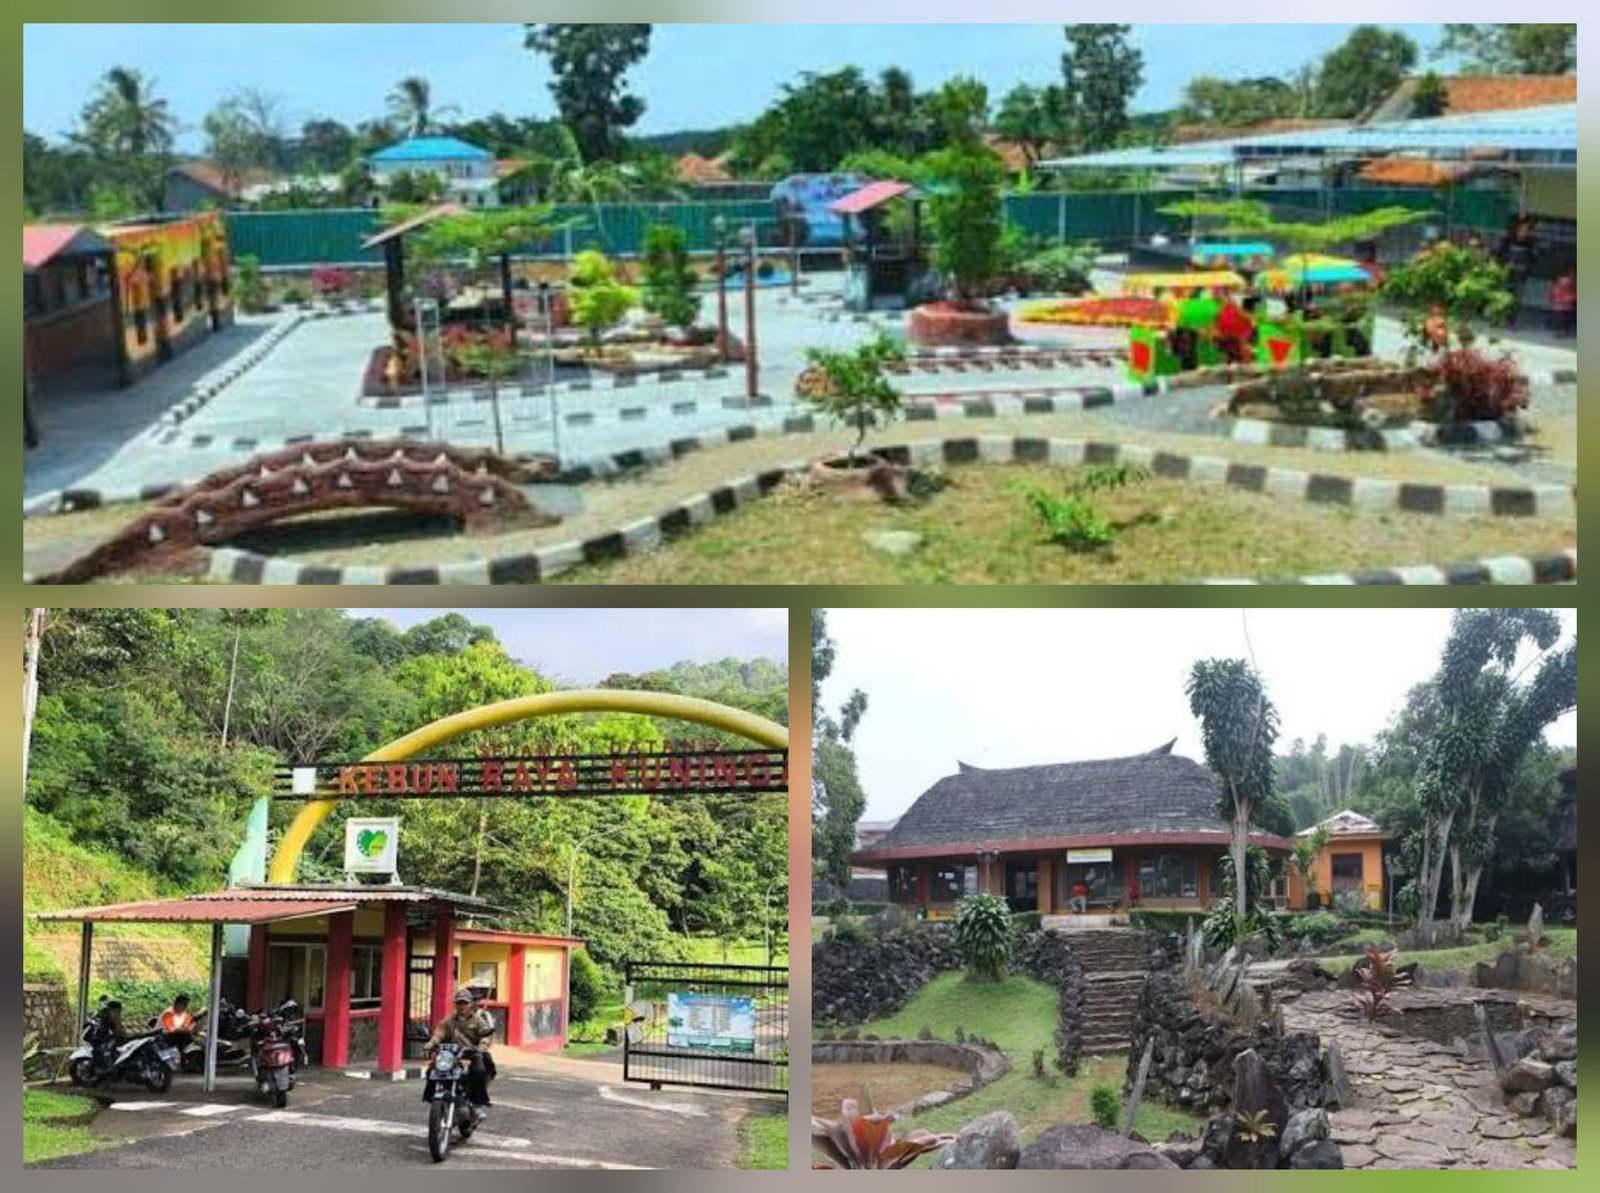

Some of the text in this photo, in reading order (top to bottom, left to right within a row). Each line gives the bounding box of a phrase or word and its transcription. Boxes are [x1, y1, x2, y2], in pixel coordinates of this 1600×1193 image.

[339, 753, 788, 793] KEBUN RAYA KUNING
